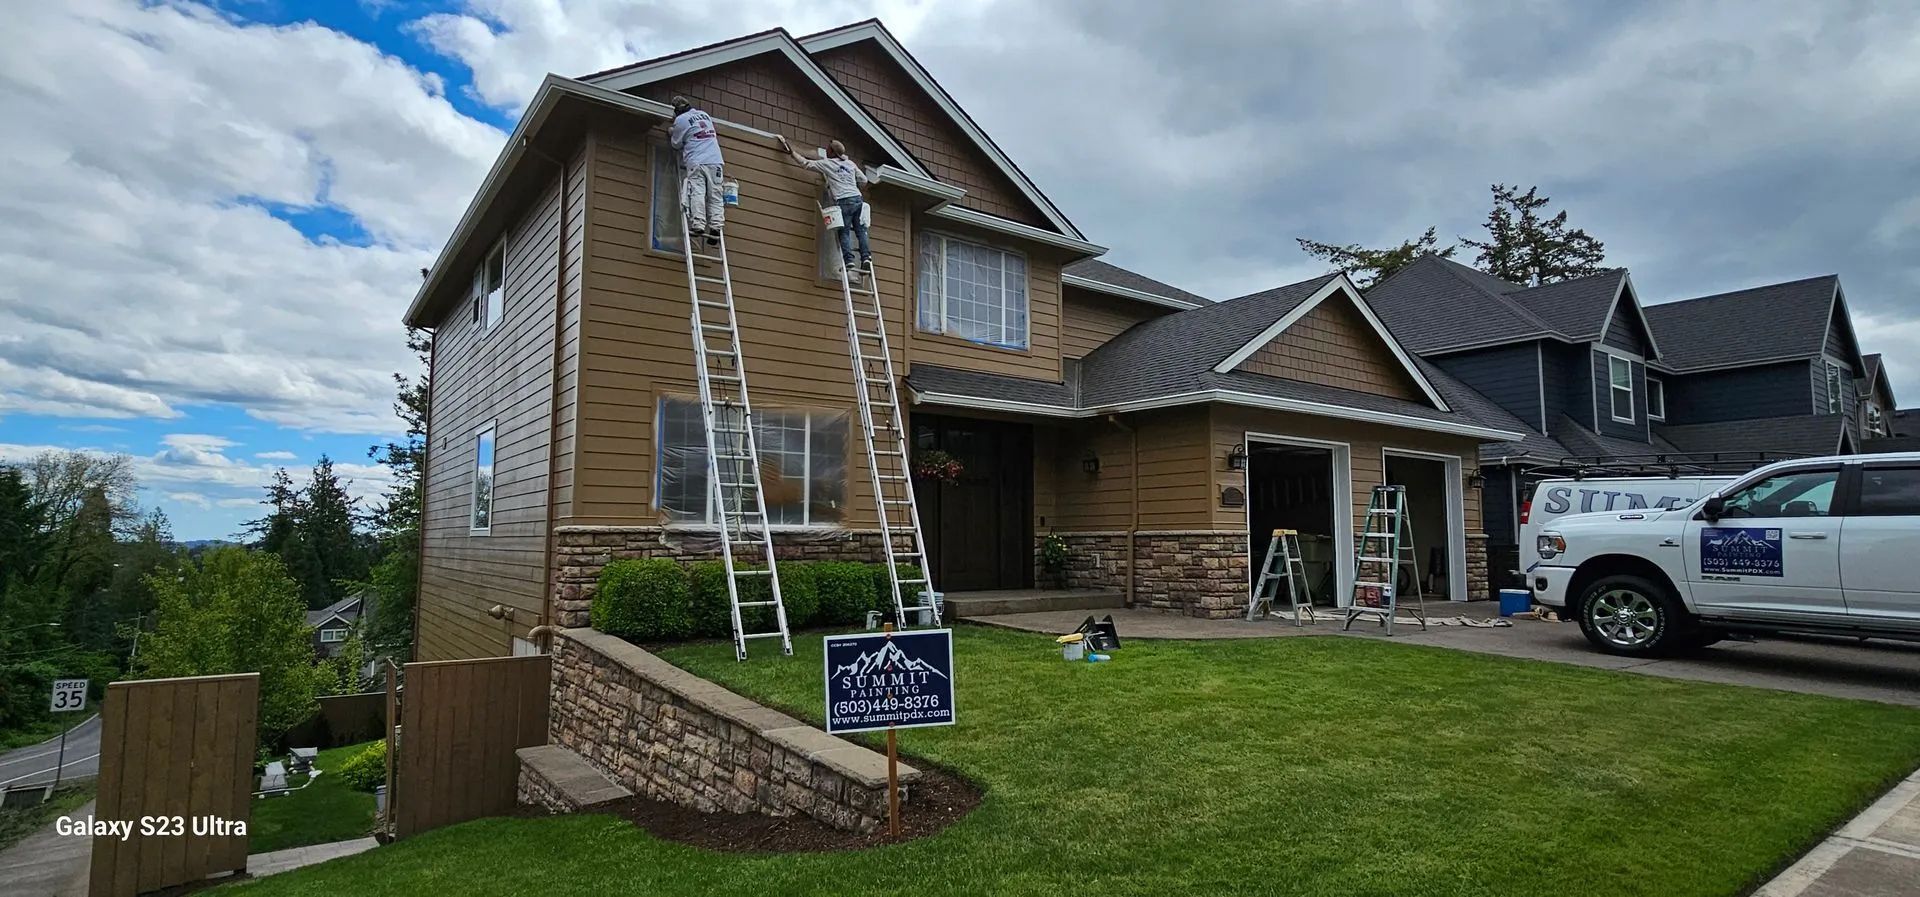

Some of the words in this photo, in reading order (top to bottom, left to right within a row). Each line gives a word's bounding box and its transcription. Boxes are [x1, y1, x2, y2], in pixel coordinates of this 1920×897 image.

[55, 682, 86, 690] SPEED
[842, 671, 930, 689] SUMMIT
[54, 690, 83, 709] 35
[850, 685, 920, 698] PAINTING
[834, 695, 939, 717] (503)449-8376
[832, 709, 950, 725] www.summitpdx.com
